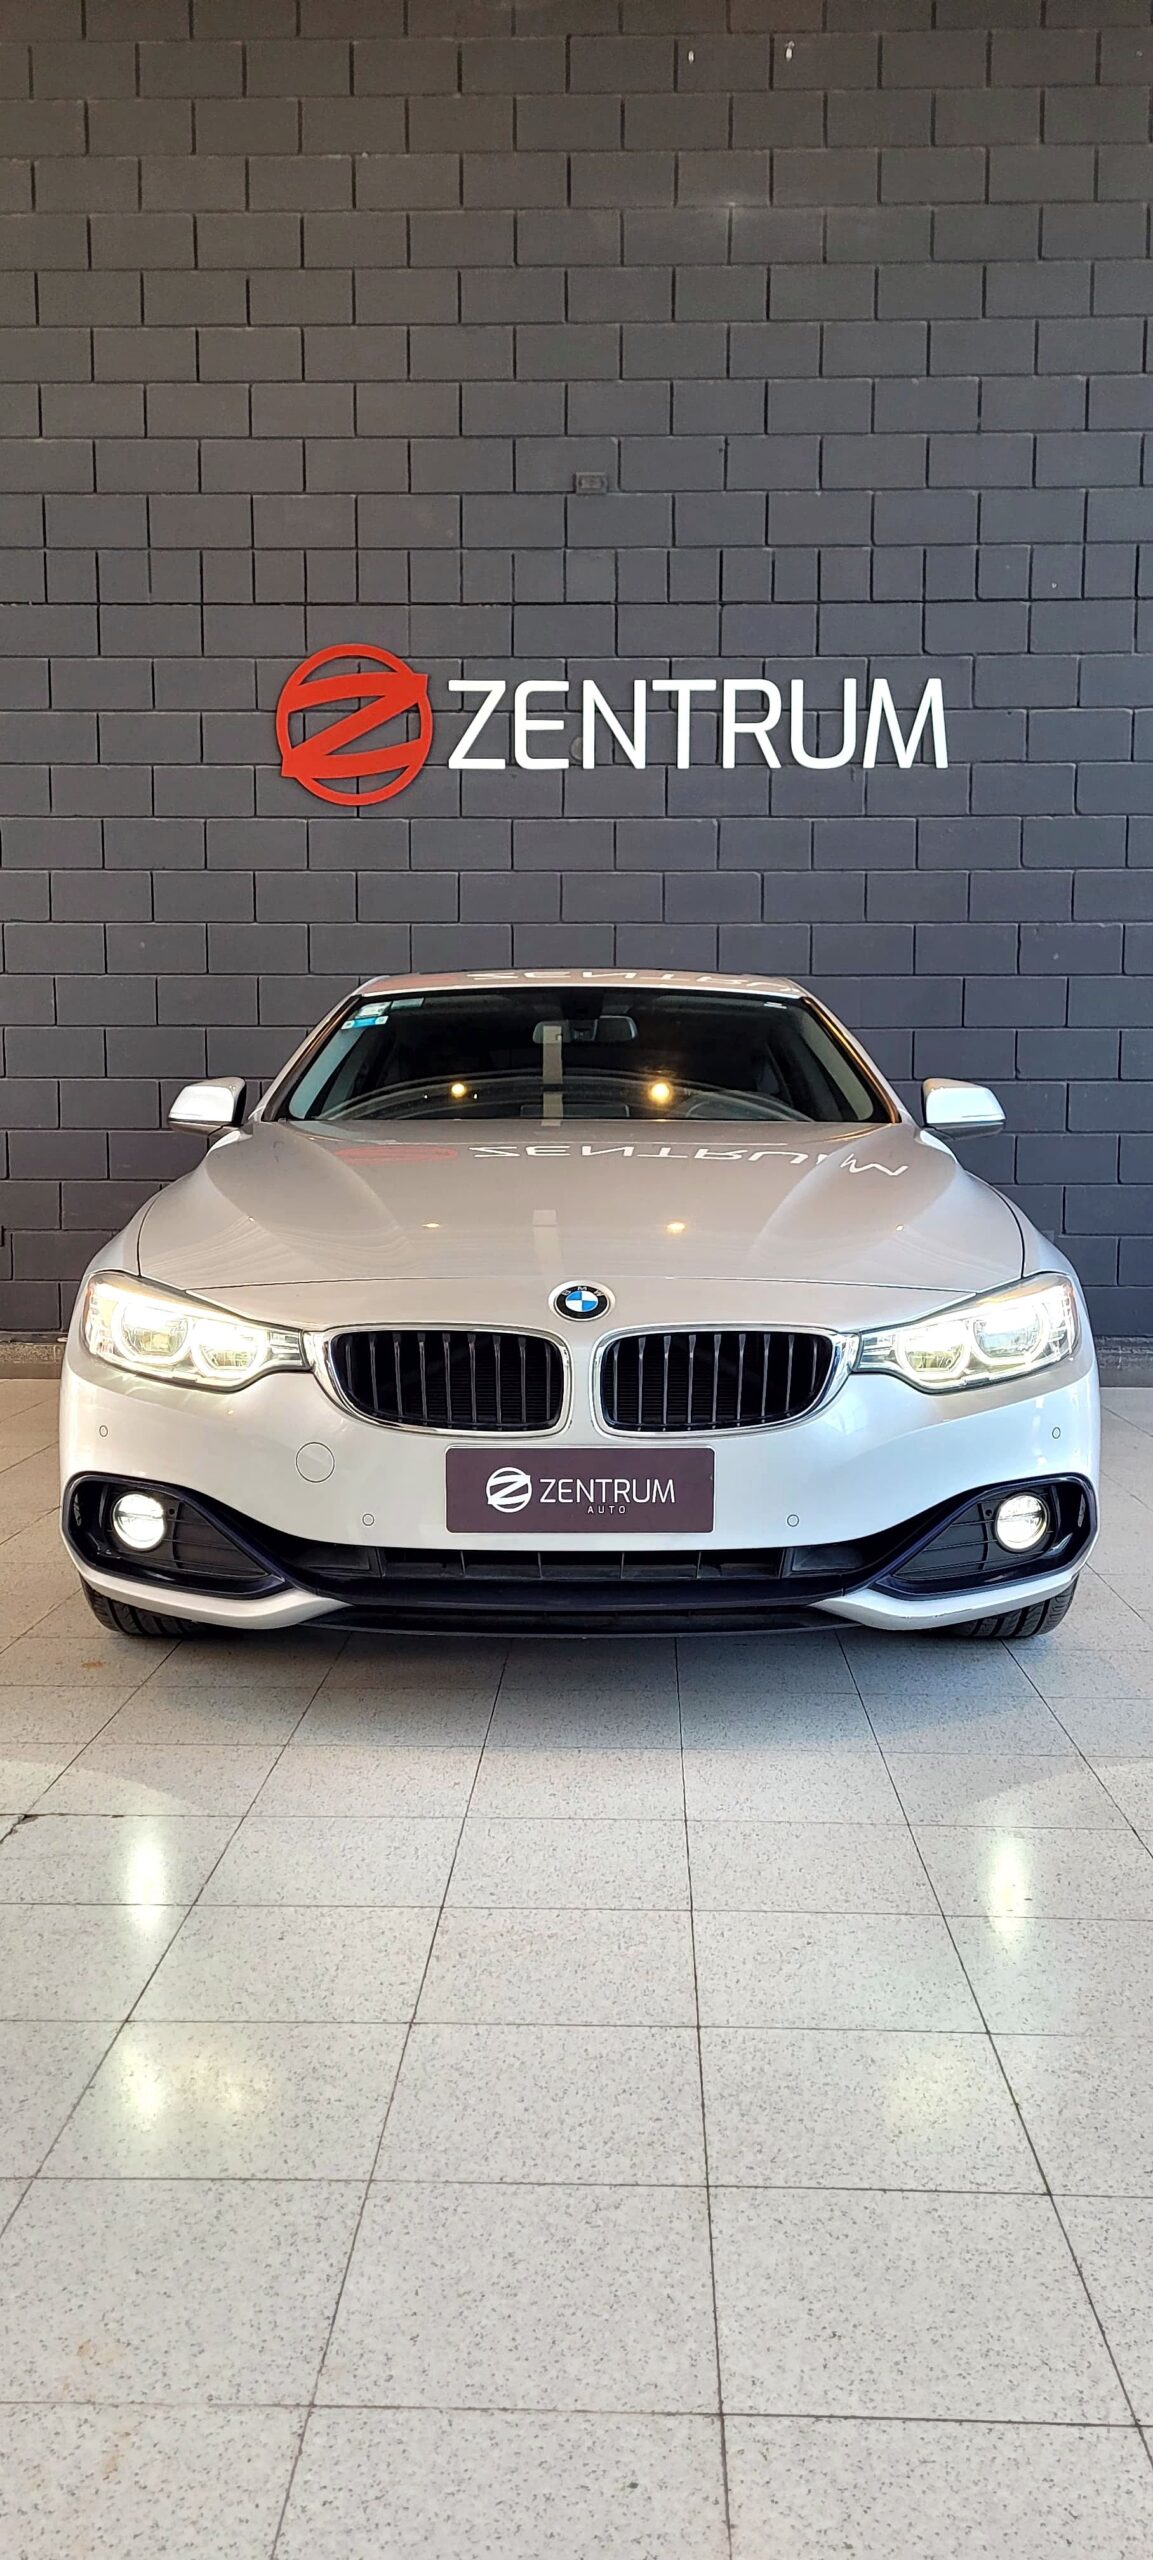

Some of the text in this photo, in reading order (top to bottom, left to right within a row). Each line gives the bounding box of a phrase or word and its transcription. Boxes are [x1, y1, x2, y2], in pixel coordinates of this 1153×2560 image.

[447, 677, 949, 771] ZENTRUM
[539, 1478, 676, 1503] ZENTRUM
[587, 1505, 627, 1514] AUTO
